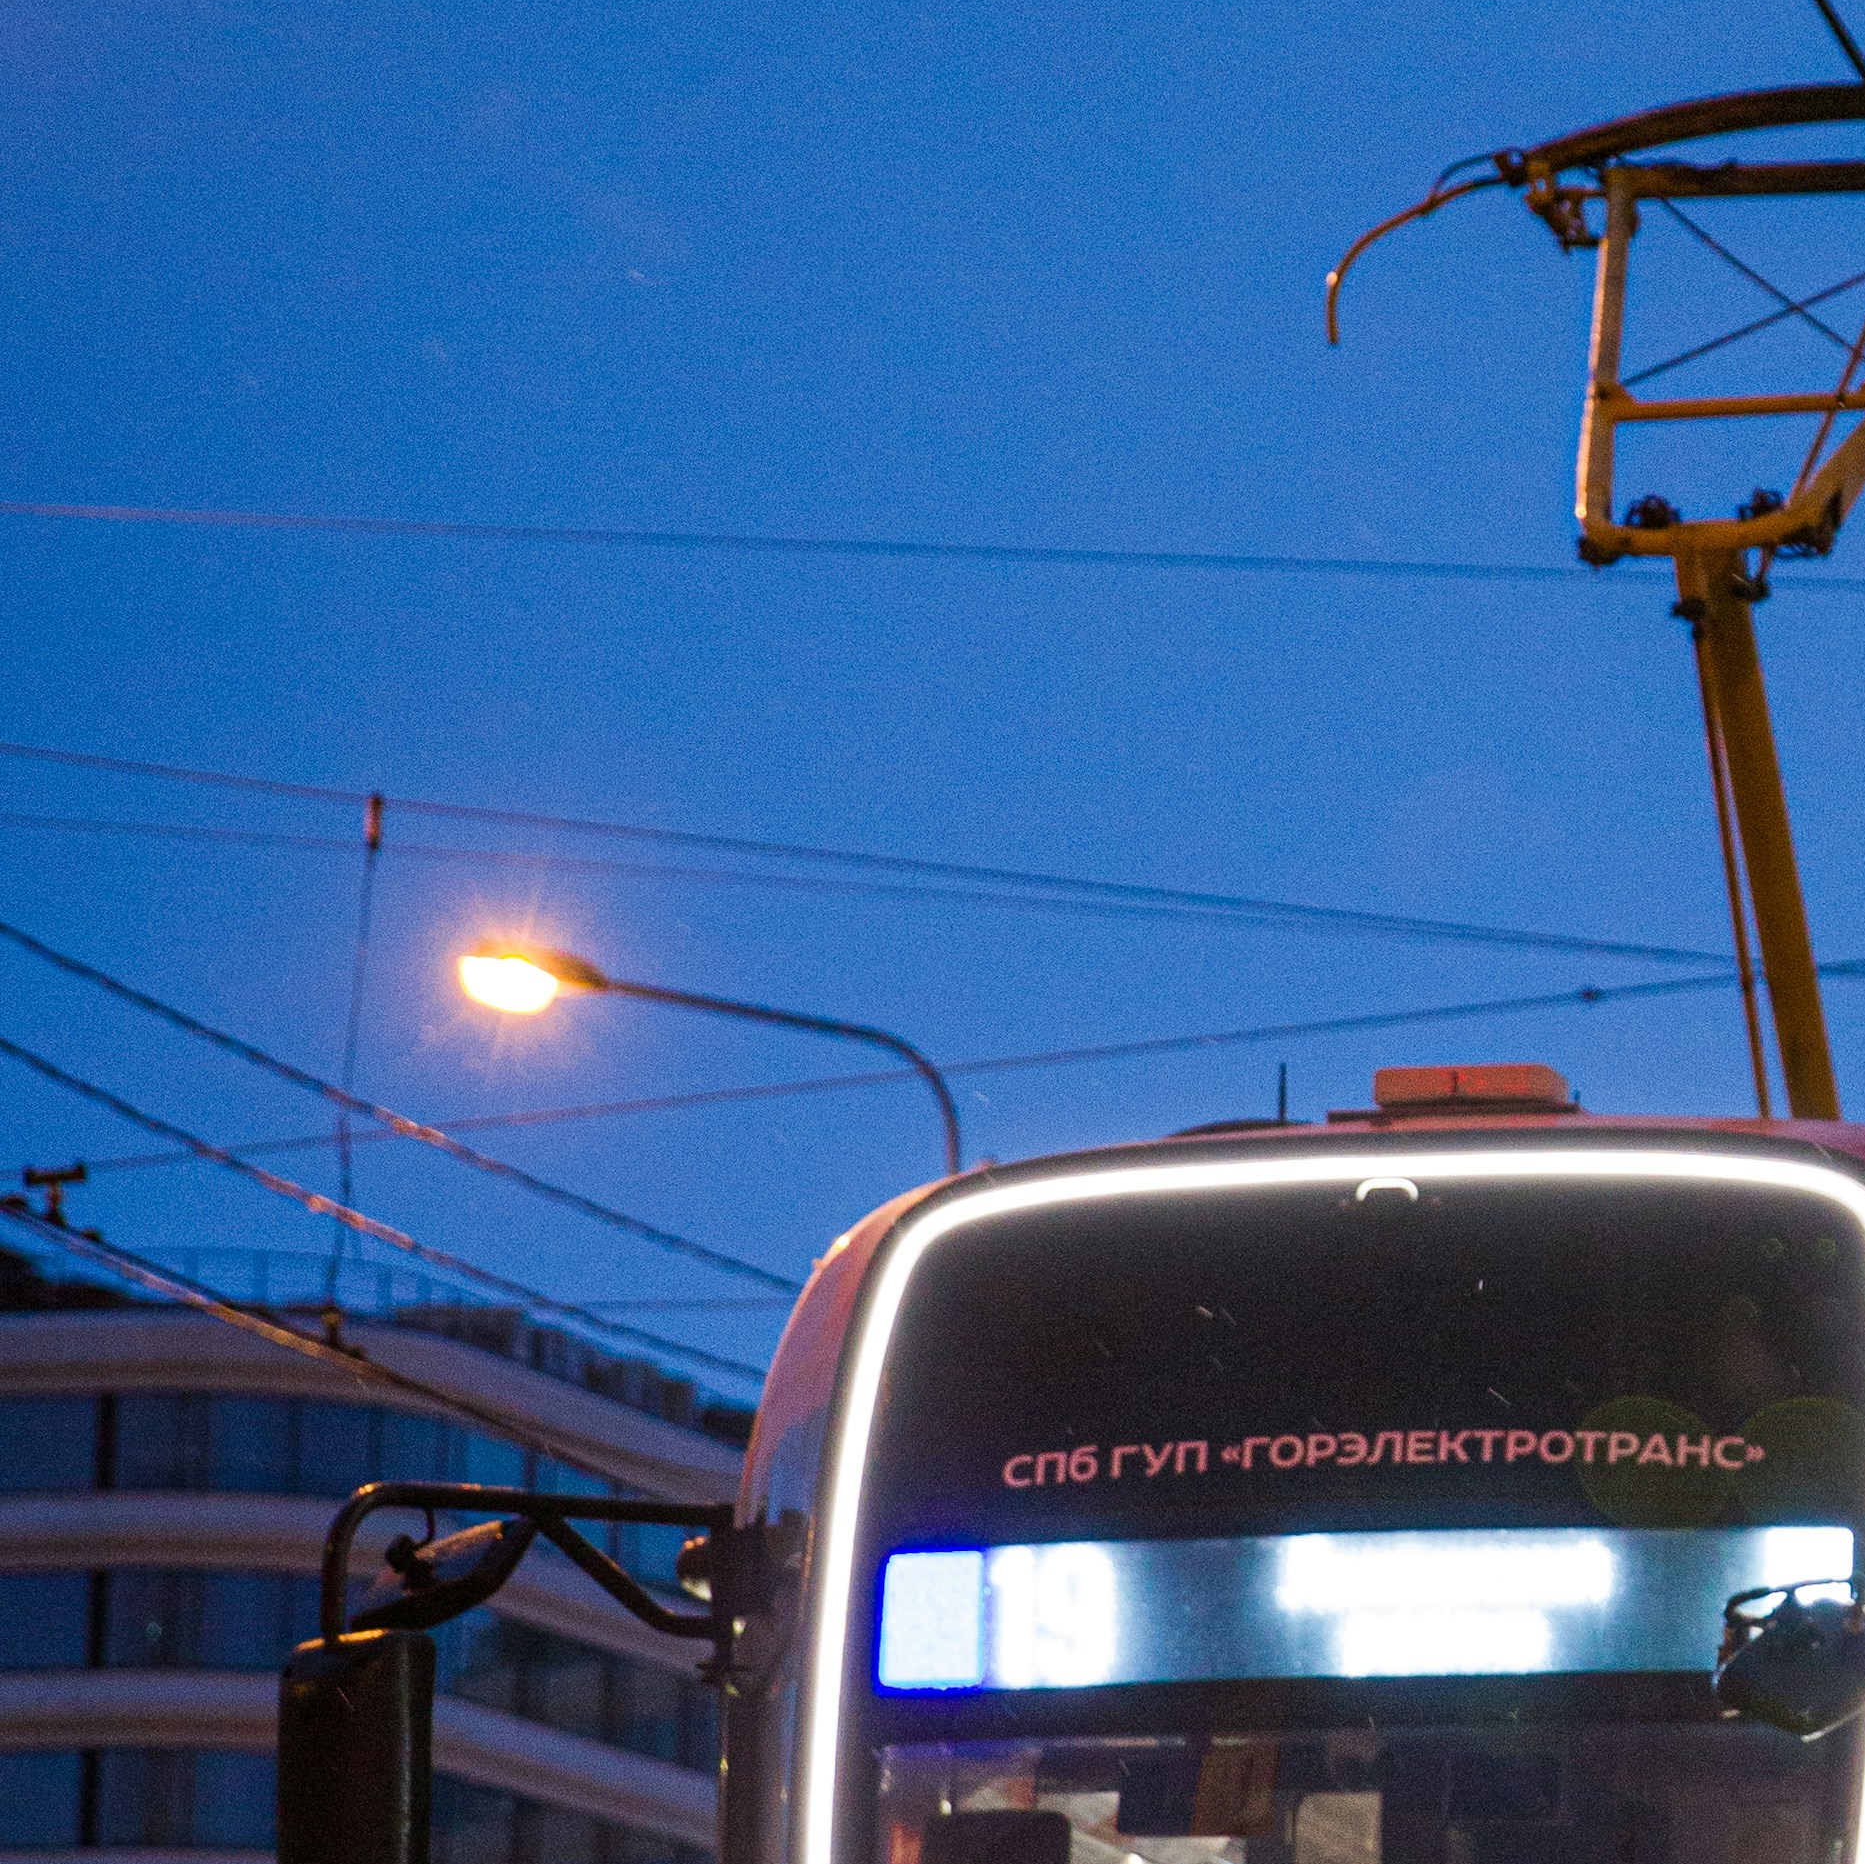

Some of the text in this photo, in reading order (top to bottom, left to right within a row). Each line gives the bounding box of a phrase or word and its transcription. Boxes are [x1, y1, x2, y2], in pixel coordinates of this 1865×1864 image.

[1110, 1441, 1209, 1479] ГУП
[1221, 1430, 1766, 1470] «ГОРЭЛЕКТРОТРАНС»
[992, 1546, 1114, 1684] 19
